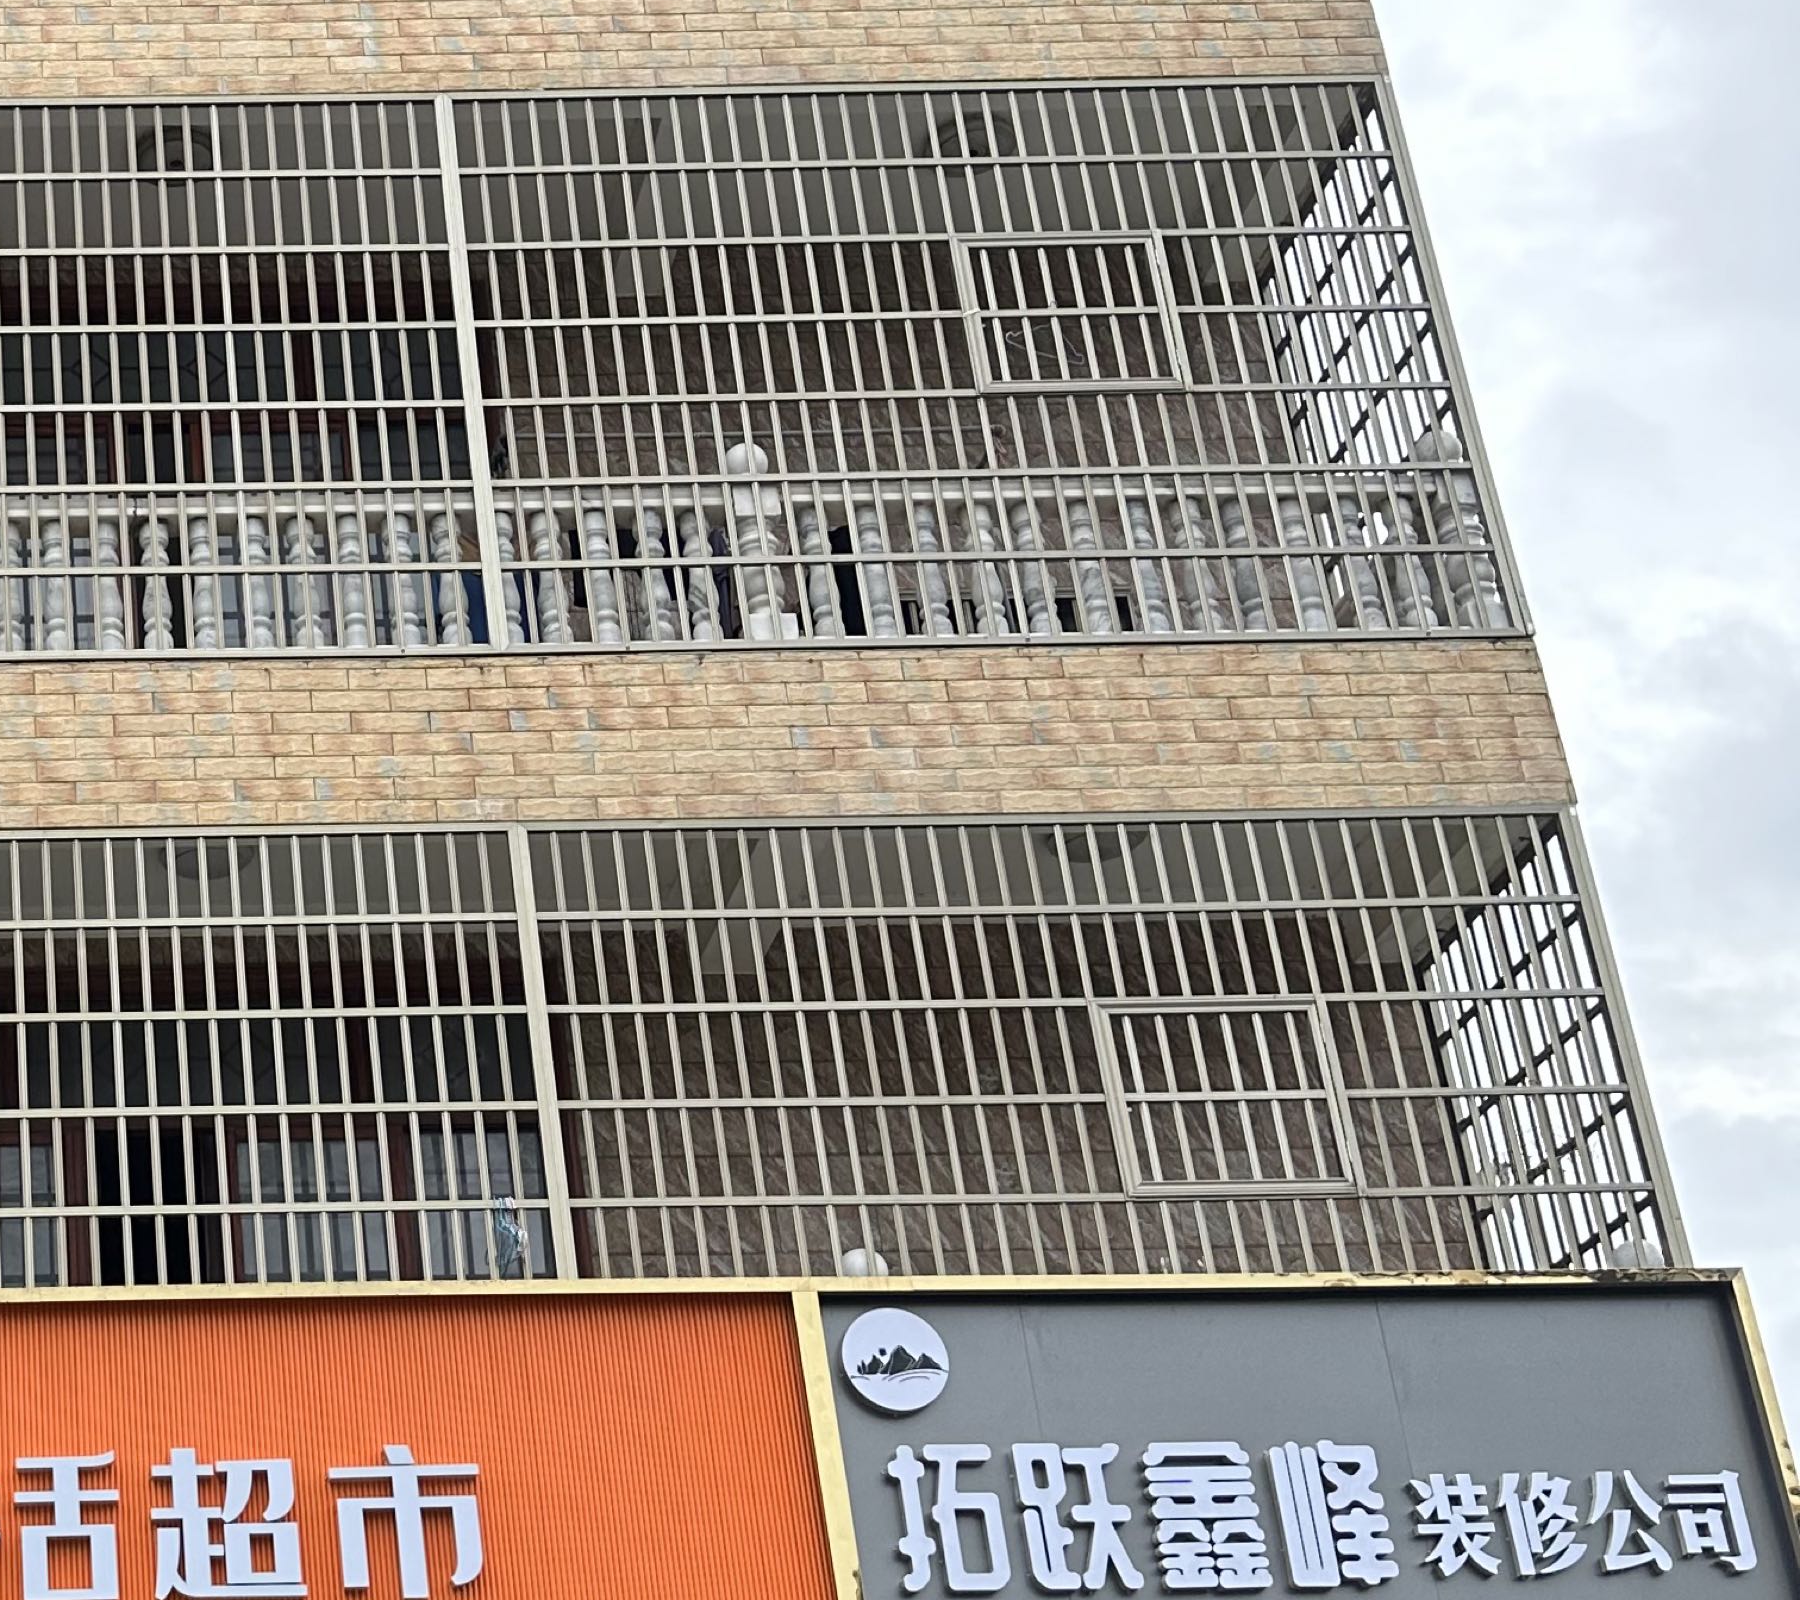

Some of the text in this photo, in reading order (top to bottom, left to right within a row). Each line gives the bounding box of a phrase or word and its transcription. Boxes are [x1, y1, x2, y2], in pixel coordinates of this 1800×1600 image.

[886, 1439, 1758, 1593] 拓跃鑫峰 装修公司
